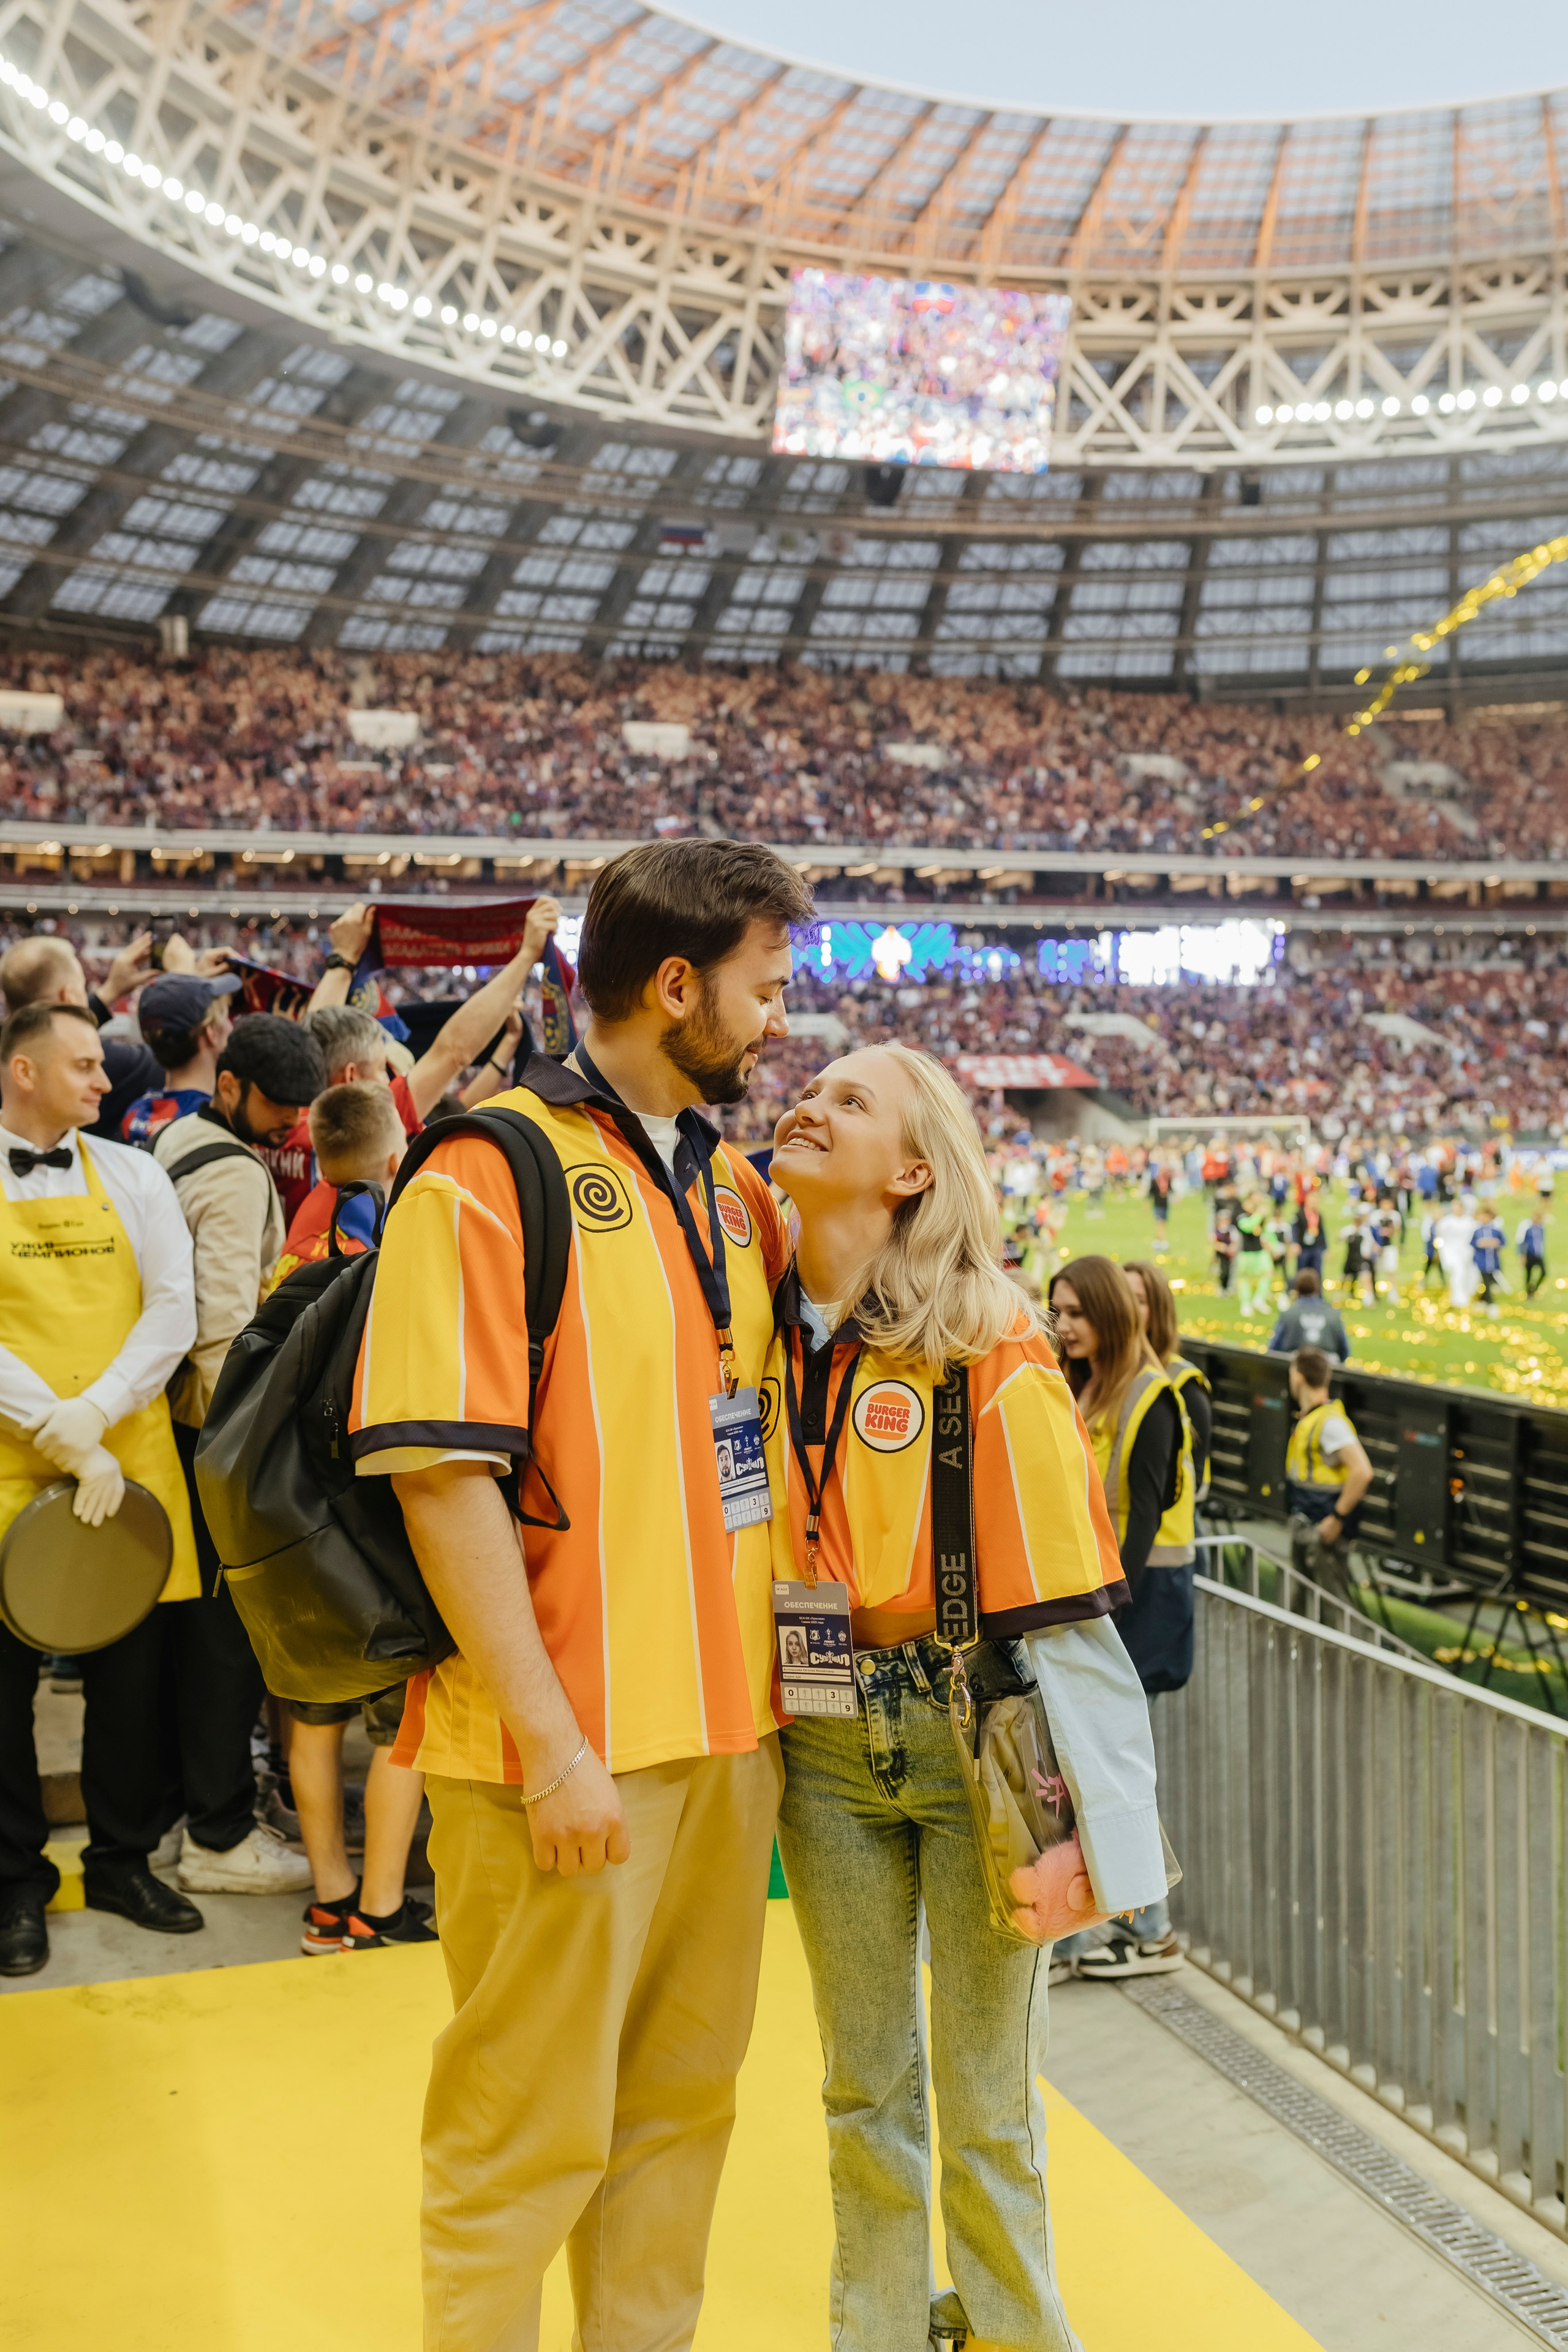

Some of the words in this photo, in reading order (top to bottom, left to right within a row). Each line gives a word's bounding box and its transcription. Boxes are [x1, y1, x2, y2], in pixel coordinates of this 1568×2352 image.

[717, 1203, 744, 1218] BURGER
[721, 1212, 746, 1231] KING
[12, 1246, 115, 1258] ЧЕМПИОНОВ
[715, 1408, 752, 1423] ОБЕСПЕЧЕНИЕ
[867, 1403, 910, 1419] BURGER
[864, 1413, 908, 1433] KING
[938, 1446, 962, 1469] A
[784, 1601, 838, 1610] ОБЕСПЕЧЕНИЕ
